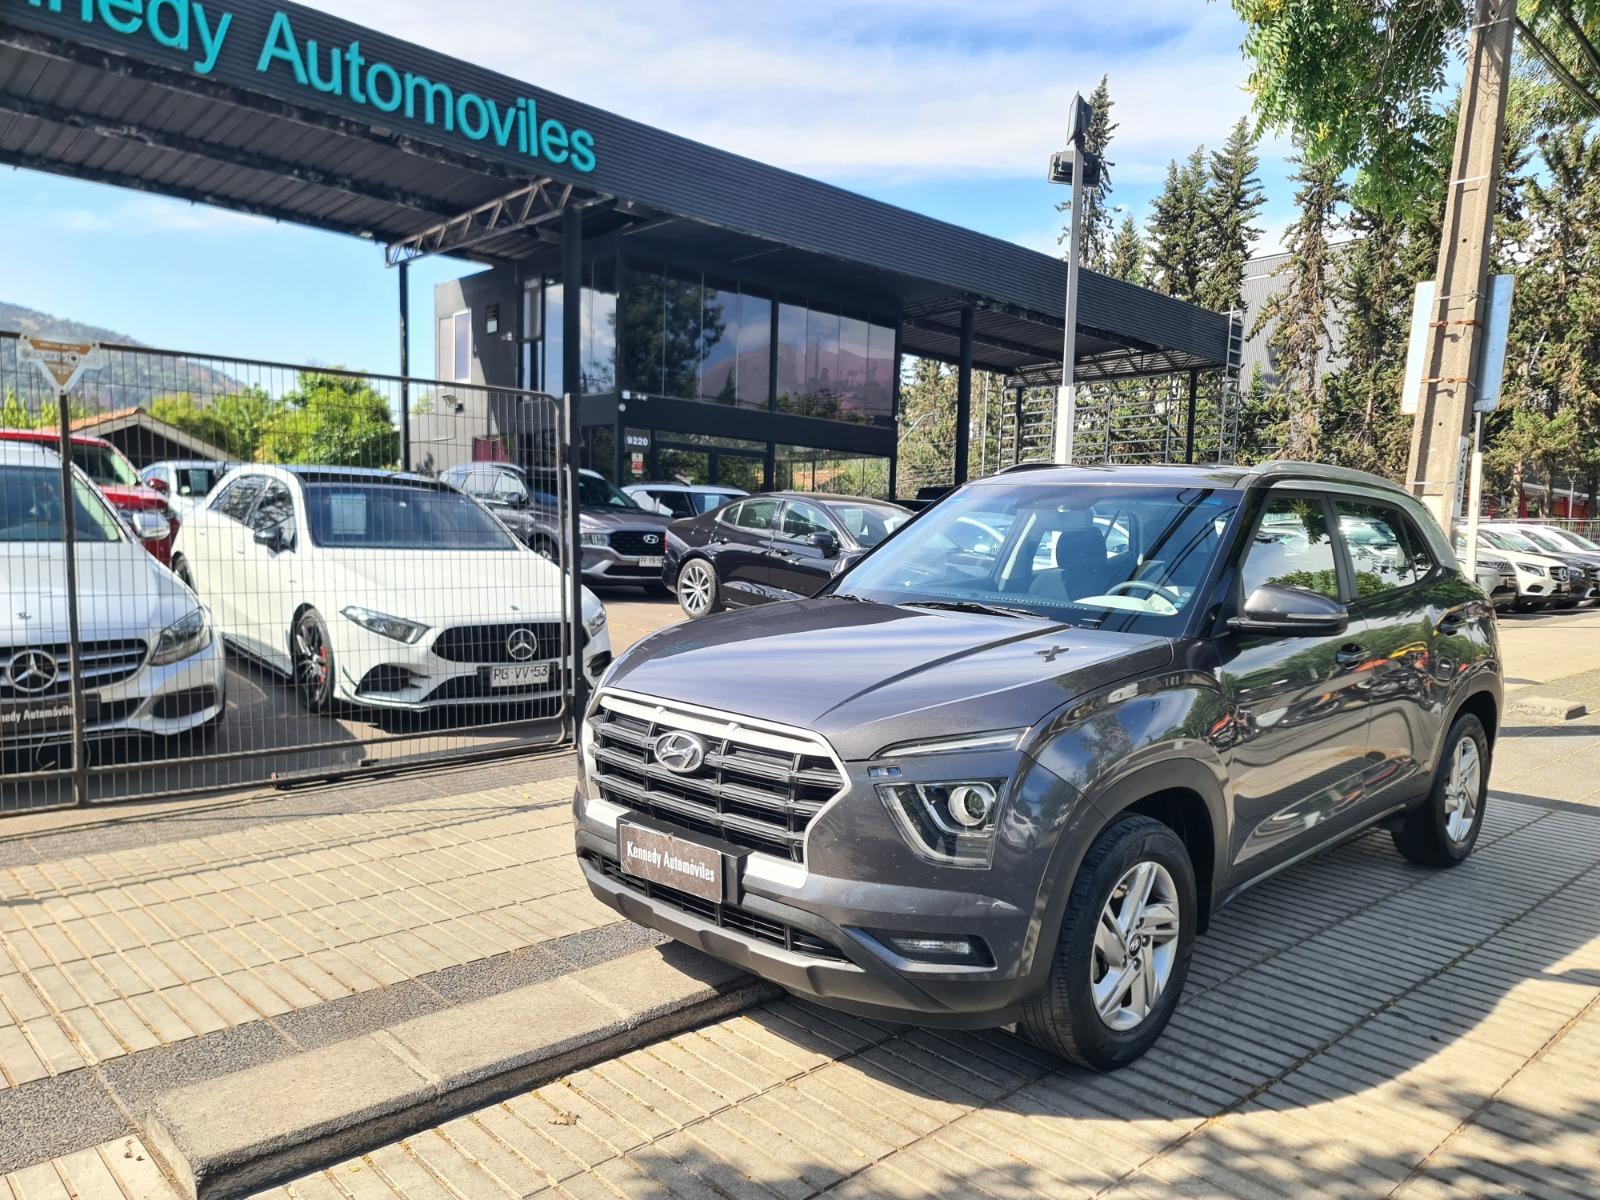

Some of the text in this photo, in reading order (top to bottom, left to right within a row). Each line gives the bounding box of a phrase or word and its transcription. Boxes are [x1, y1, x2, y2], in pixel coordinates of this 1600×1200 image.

[256, 12, 597, 173] Automoviles
[627, 435, 649, 446] 9220
[23, 705, 76, 720] Automóvile
[626, 840, 715, 882] Kennedy Automóviles
